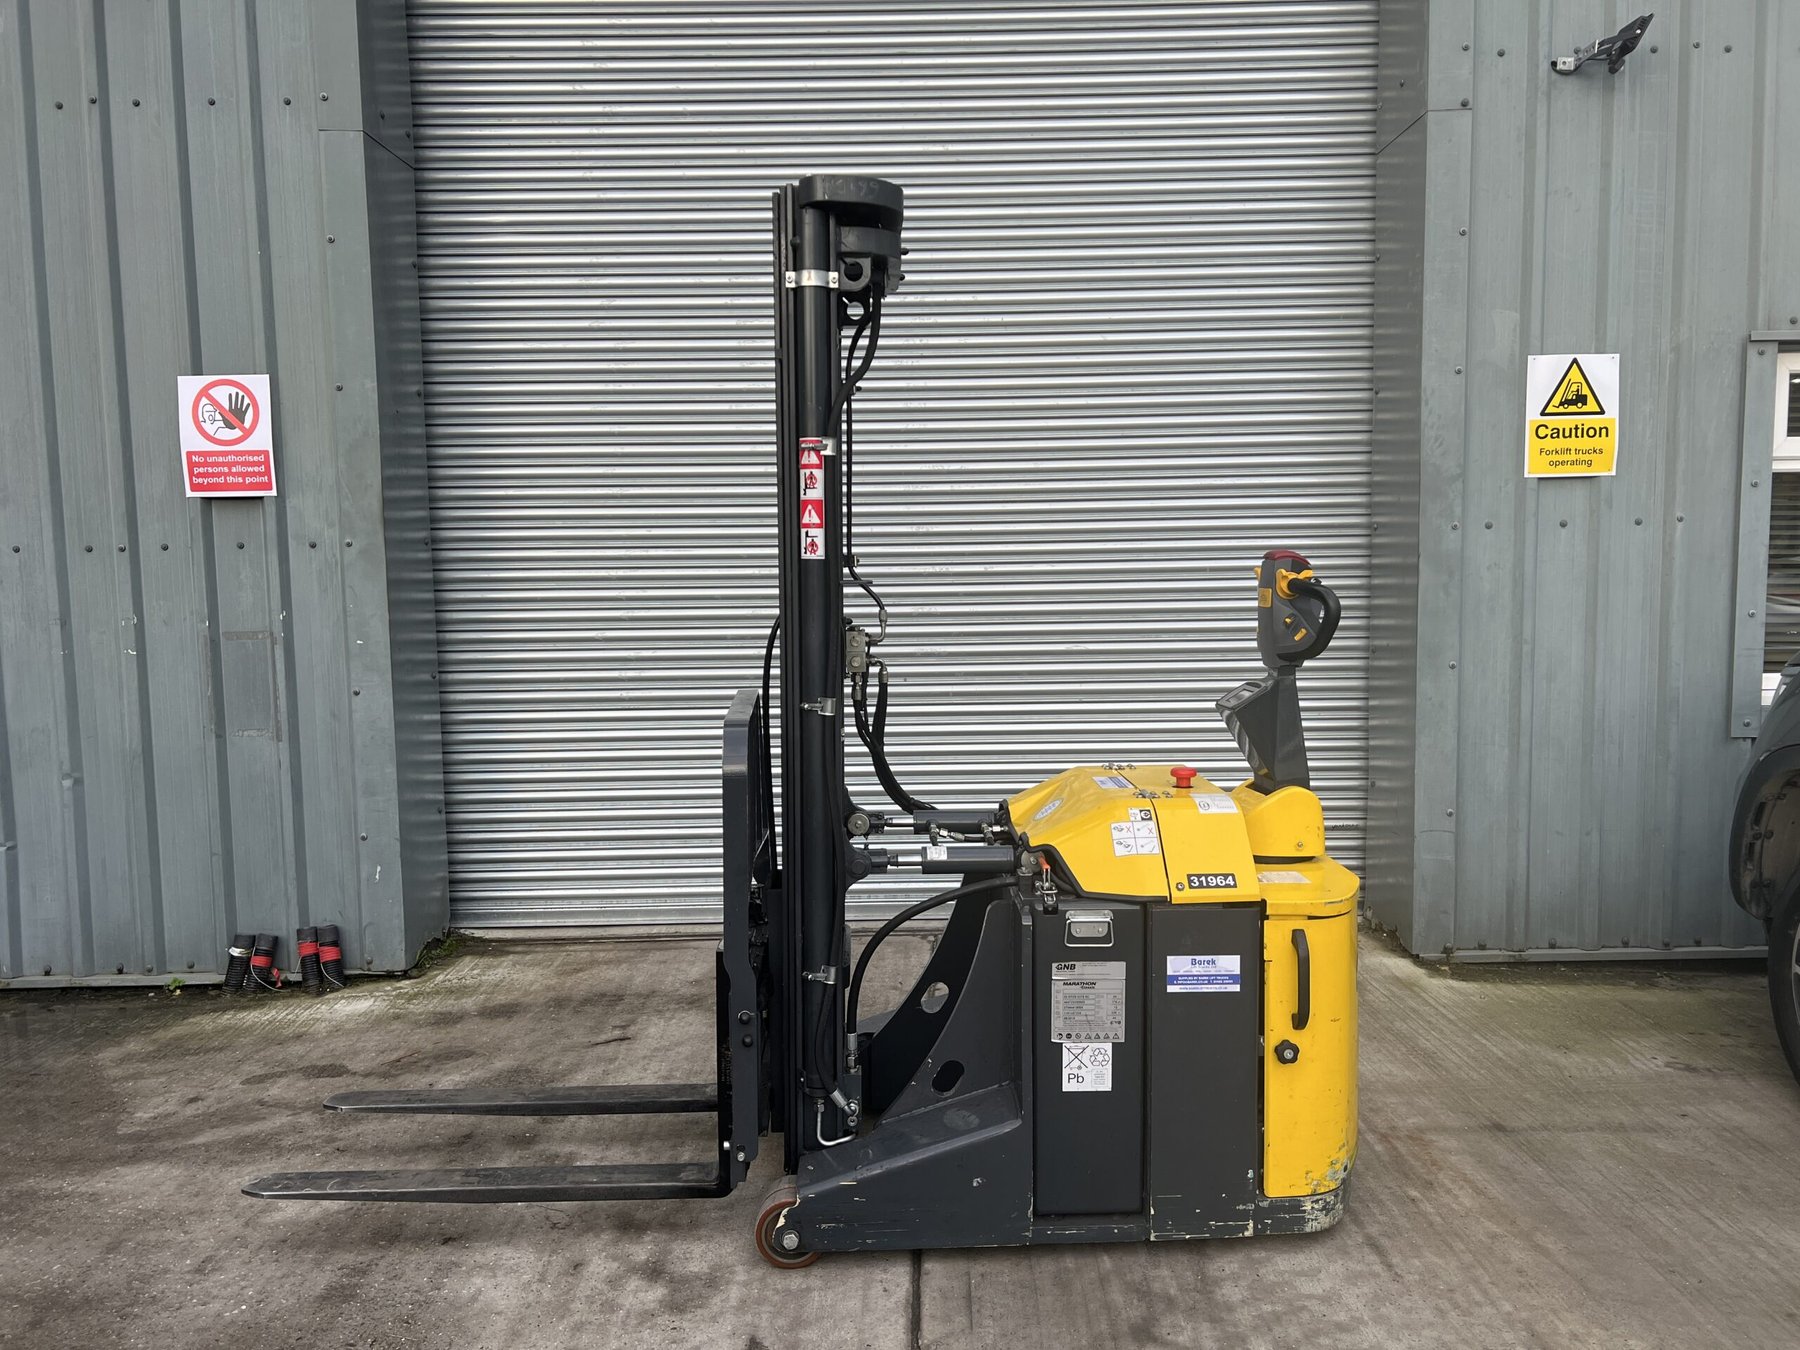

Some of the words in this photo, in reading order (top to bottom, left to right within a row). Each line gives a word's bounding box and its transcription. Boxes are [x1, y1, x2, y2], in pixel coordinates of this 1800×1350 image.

[1535, 423, 1609, 440] Caution
[1539, 447, 1572, 456] Forklift
[1574, 447, 1604, 455] trucks
[206, 454, 264, 462] unauthorised
[1548, 458, 1593, 468] operating
[193, 465, 229, 474] persons
[231, 464, 265, 472] allowed
[192, 476, 225, 484] beyond
[245, 475, 268, 484] point
[1190, 875, 1235, 887] 31964
[1055, 963, 1076, 971] GNB
[1067, 1073, 1085, 1084] Pb
